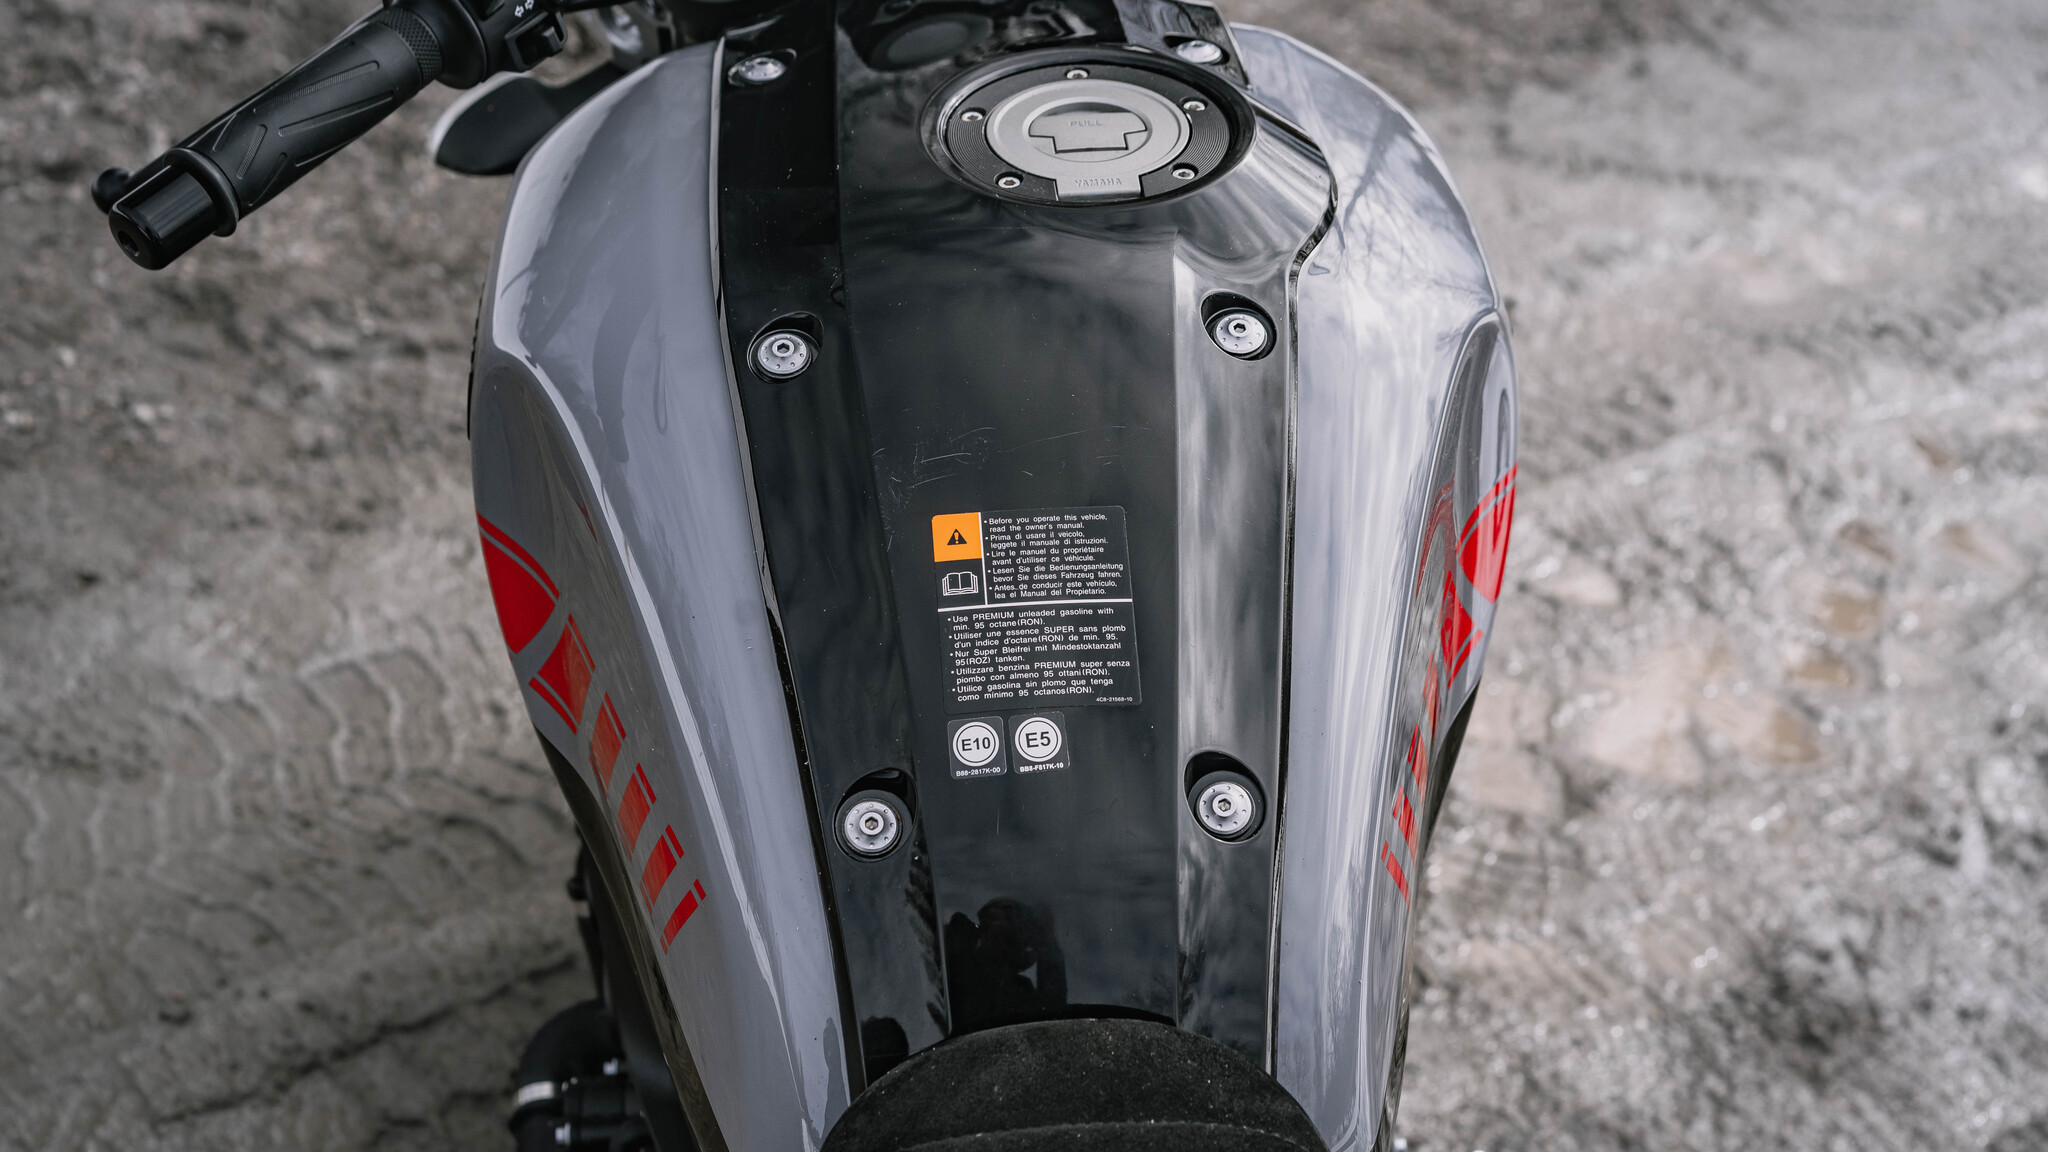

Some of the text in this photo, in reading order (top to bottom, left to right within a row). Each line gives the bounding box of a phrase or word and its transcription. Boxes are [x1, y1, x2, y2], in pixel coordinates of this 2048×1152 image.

[1069, 119, 1103, 127] PULL
[1074, 177, 1122, 188] YAMAHA
[1033, 515, 1060, 523] operate
[991, 541, 1017, 550] leggete
[1063, 546, 1104, 555] propriétaire
[1050, 563, 1123, 571] Bedienungsanleitung
[1032, 581, 1063, 589] conducir
[1020, 589, 1047, 597] Manual
[1066, 588, 1106, 596] Propietario.
[973, 611, 1014, 620] PREMIUM
[1019, 609, 1055, 617] unleaded
[1060, 608, 1093, 617] gasoline
[989, 618, 1045, 628] octane(RON).
[954, 632, 982, 640] Utiliser
[1044, 626, 1074, 634] SUPER
[1102, 625, 1126, 633] plomb
[1004, 635, 1064, 644] d'octane(RON)
[1002, 646, 1030, 654] Bleifrei
[1052, 642, 1121, 651] Mindestoktanzahl
[955, 655, 1025, 666] 95(ROZ) tanken.
[956, 667, 994, 675] Utilizzare
[1034, 661, 1076, 669] PREMIUM
[957, 675, 986, 685] piombo
[1058, 668, 1110, 677] ottani(RON).
[957, 685, 982, 693] Utilice
[987, 682, 1021, 692] gasolina
[1042, 680, 1066, 688] plomo
[1071, 679, 1086, 687] que
[1091, 678, 1113, 686] tenga
[1034, 686, 1094, 696] octanos(RON).
[961, 736, 991, 752] E10
[1025, 731, 1051, 749] E5
